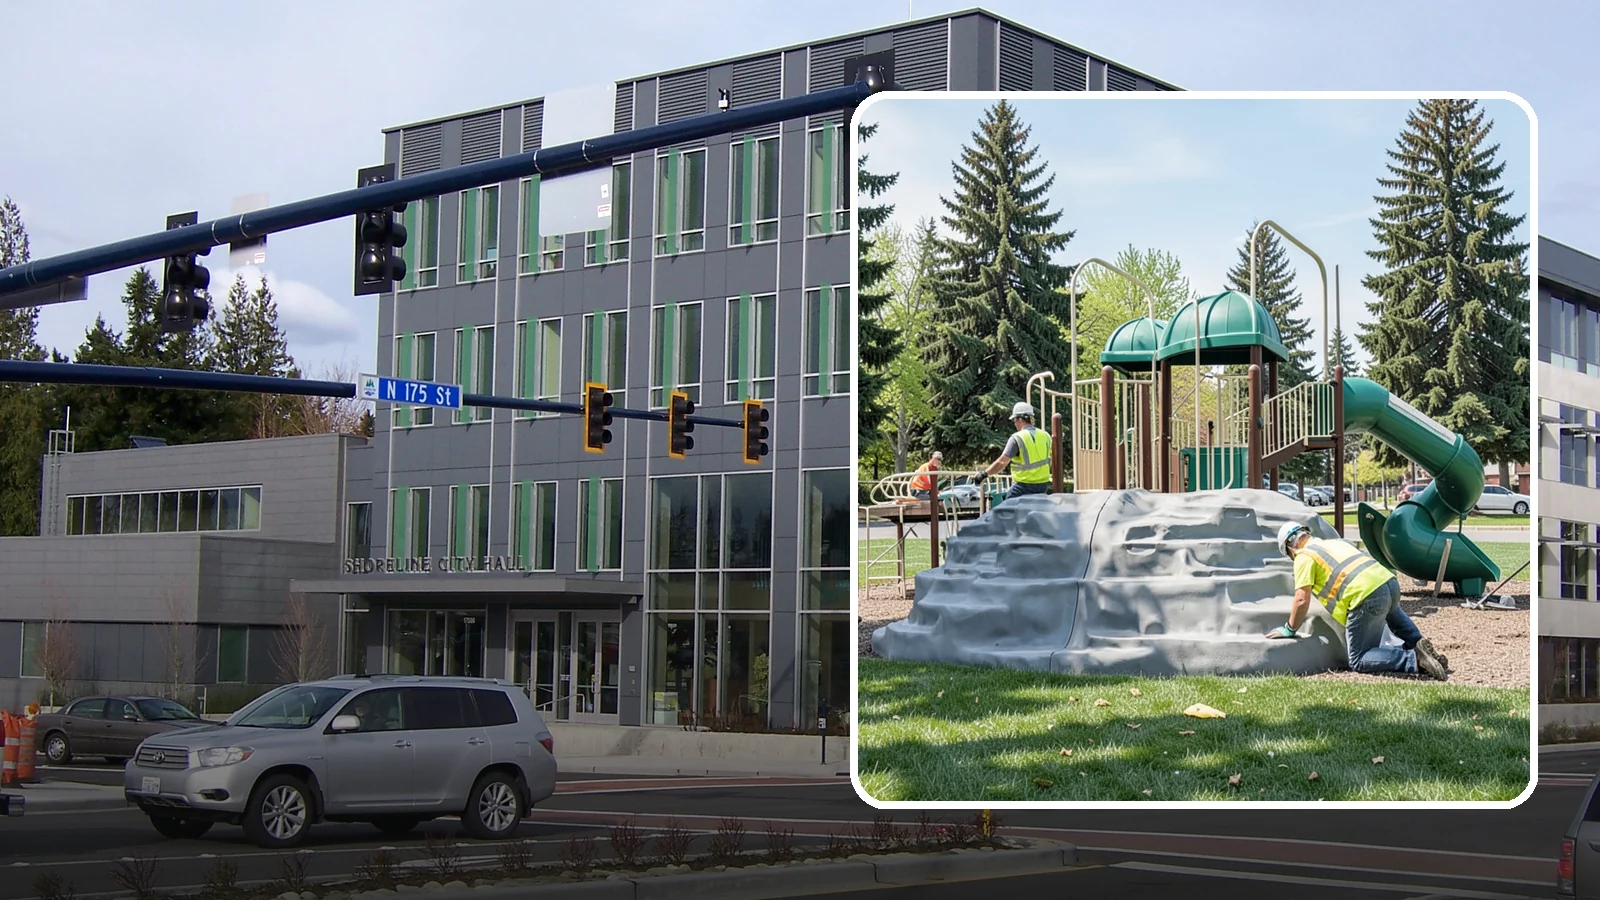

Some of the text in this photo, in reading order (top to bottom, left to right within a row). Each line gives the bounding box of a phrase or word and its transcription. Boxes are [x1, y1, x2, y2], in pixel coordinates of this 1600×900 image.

[387, 380, 451, 406] N 175 St
[344, 555, 526, 574] SHORELINE CITY HALL
